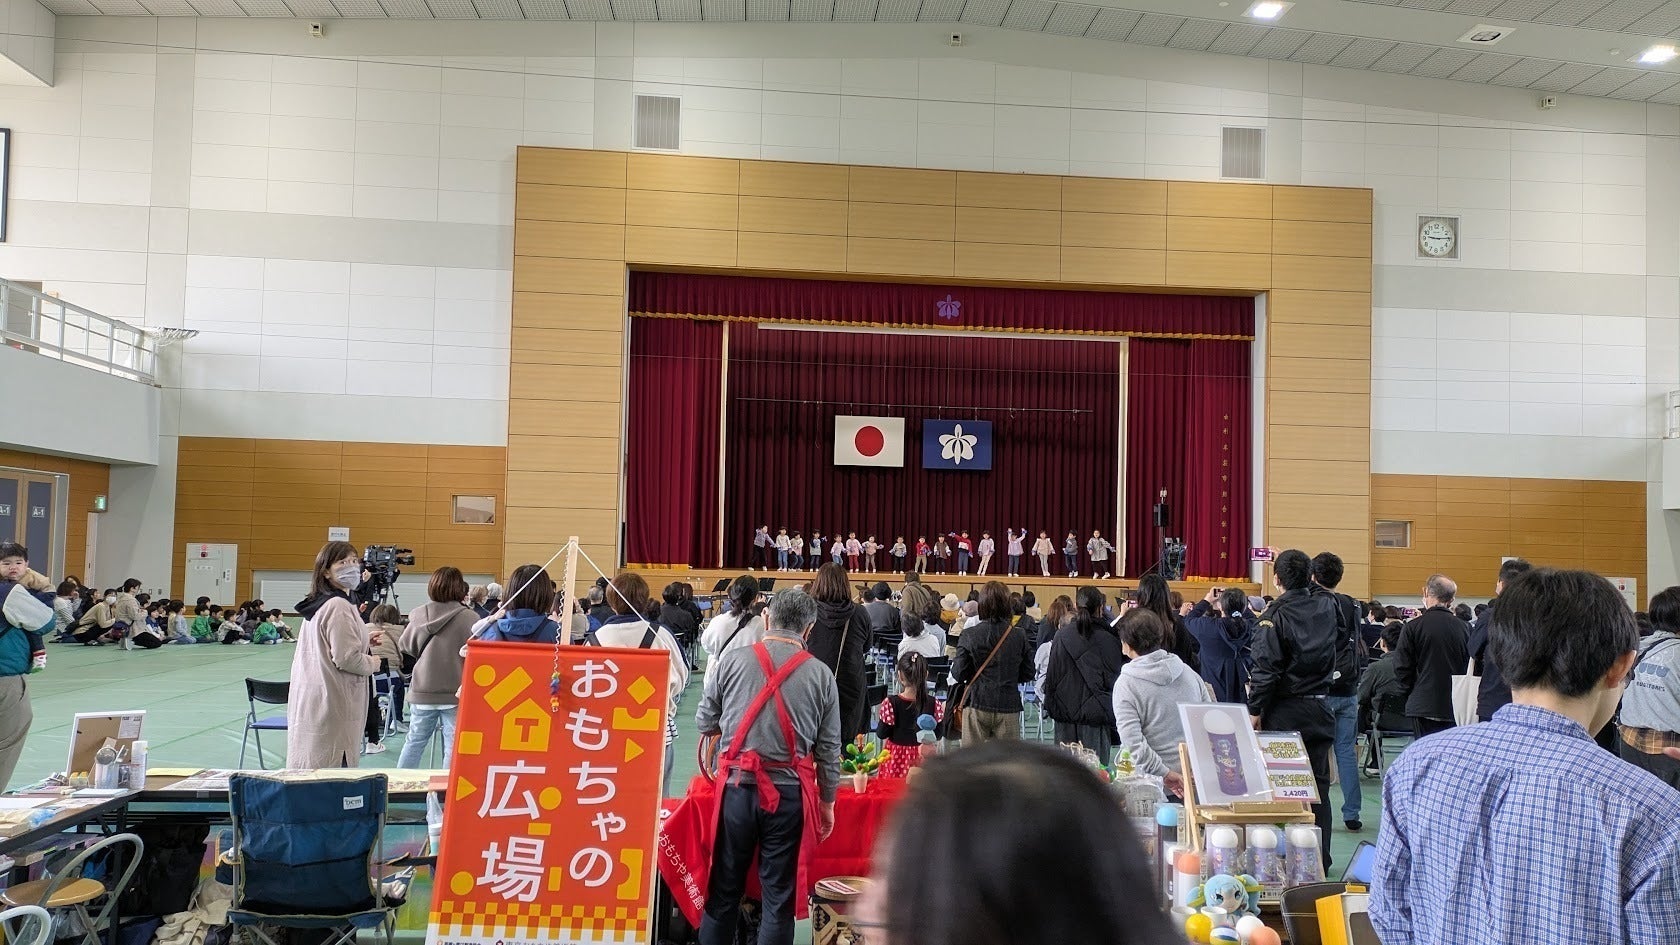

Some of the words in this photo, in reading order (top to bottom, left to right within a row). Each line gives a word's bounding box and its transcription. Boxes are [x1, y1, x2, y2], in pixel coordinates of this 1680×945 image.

[33, 508, 45, 516] A-1
[476, 759, 547, 903] 広場
[565, 658, 627, 888] おもちゃの
